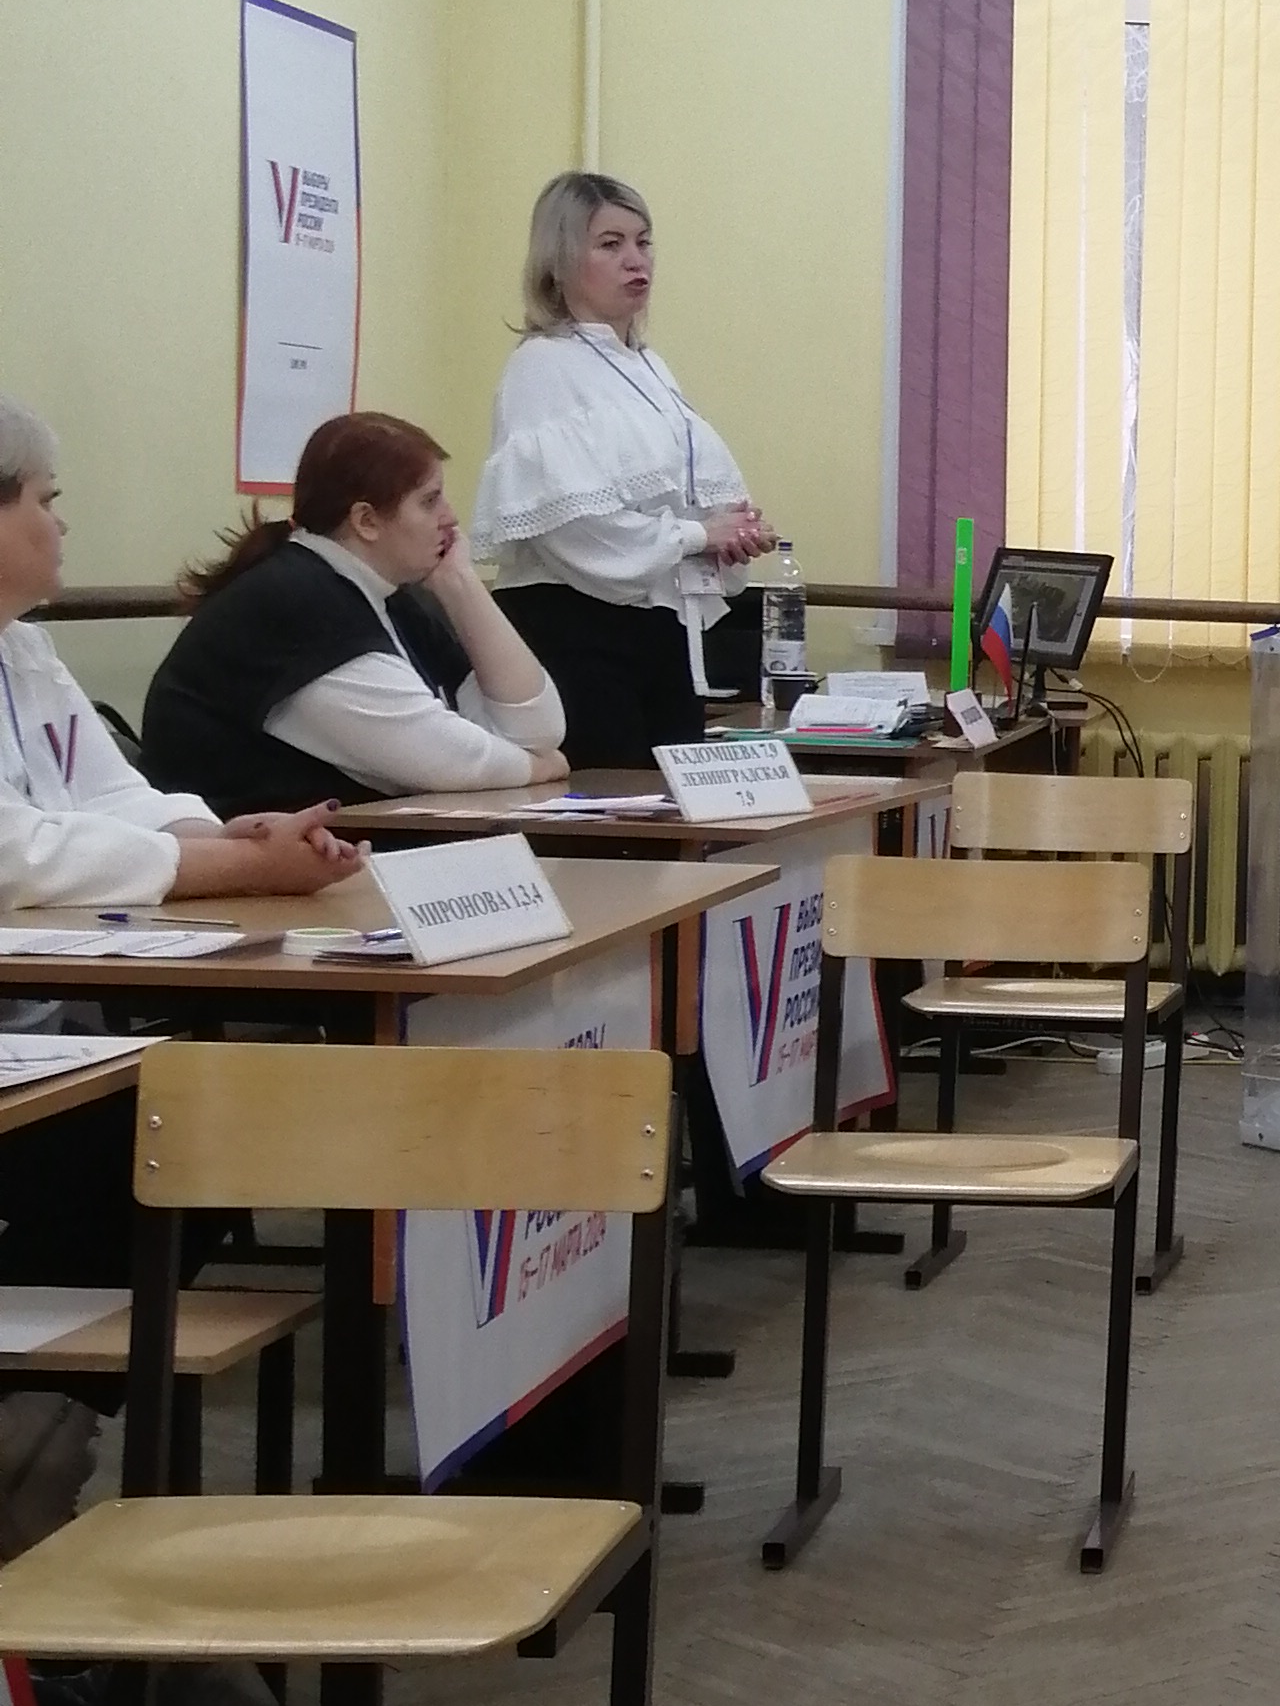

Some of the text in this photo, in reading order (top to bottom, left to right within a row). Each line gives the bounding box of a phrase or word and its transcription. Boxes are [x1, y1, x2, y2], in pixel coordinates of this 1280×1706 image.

[669, 743, 761, 766] КАДОМЦЕВА
[681, 764, 790, 787] ЛЕНИНГРАДСКАЯ
[408, 890, 511, 929] МИРОНОВА
[796, 892, 824, 933] ВЫБО
